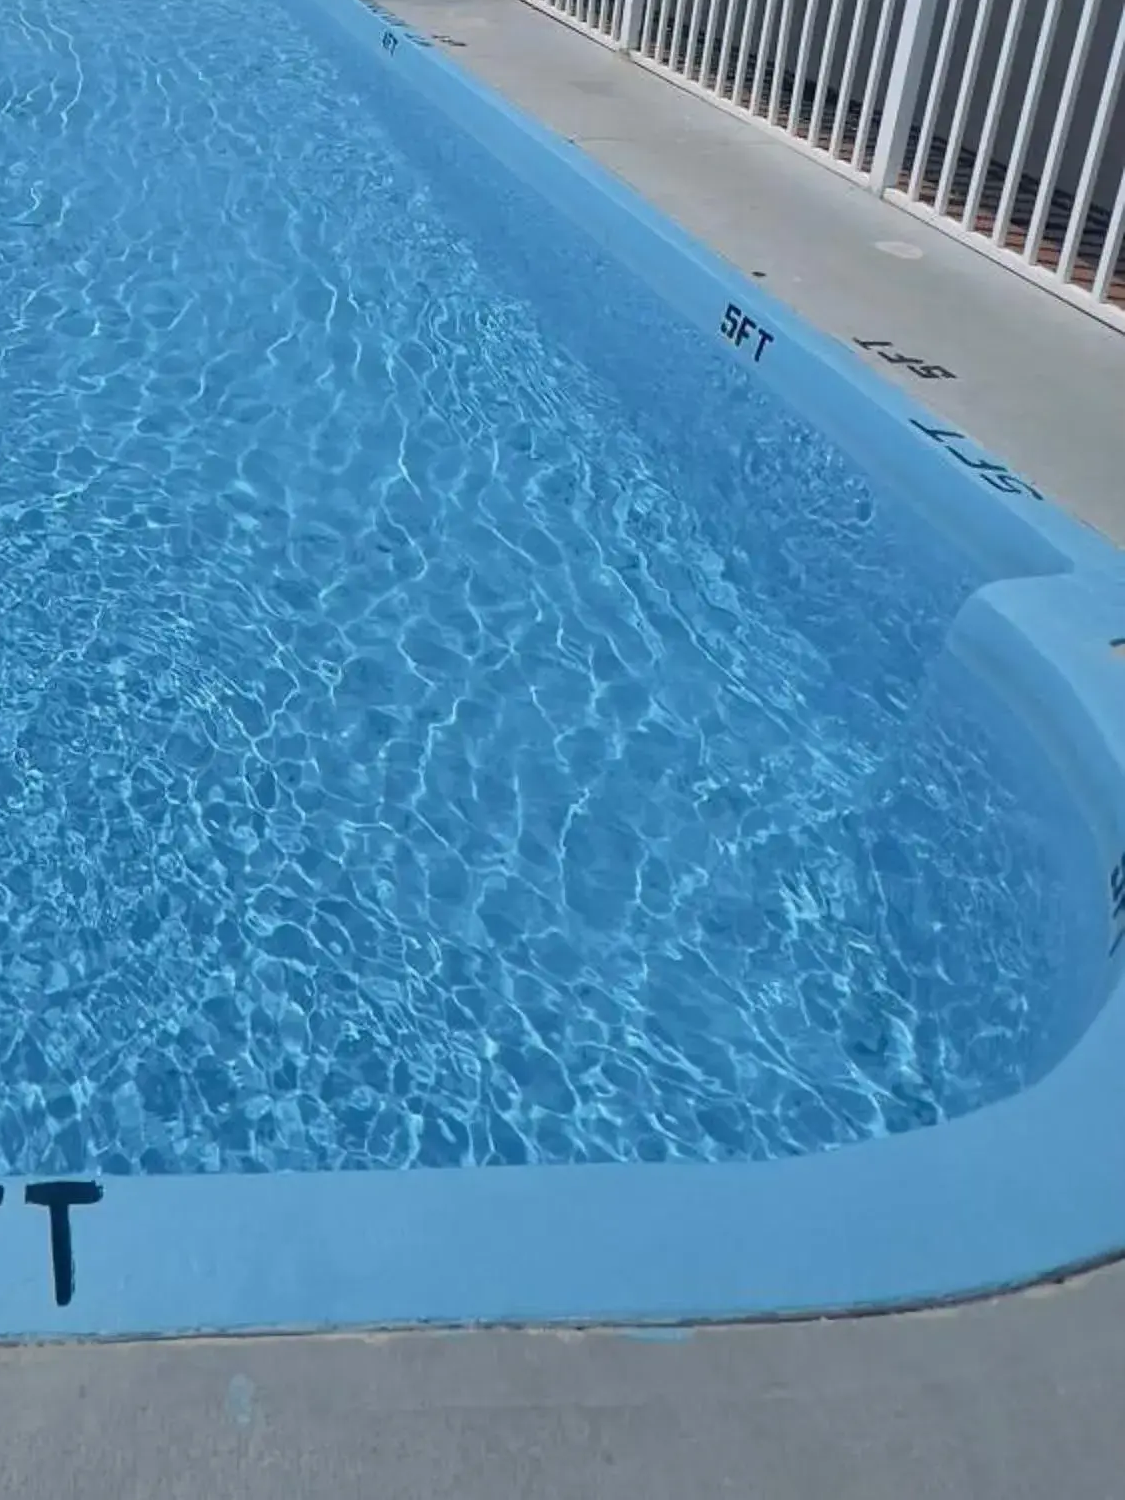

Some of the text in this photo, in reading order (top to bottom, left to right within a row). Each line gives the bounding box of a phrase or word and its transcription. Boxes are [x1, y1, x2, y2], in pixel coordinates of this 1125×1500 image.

[721, 304, 774, 362] 5FT
[853, 337, 958, 380] 5FT
[909, 418, 1044, 501] 5FT
